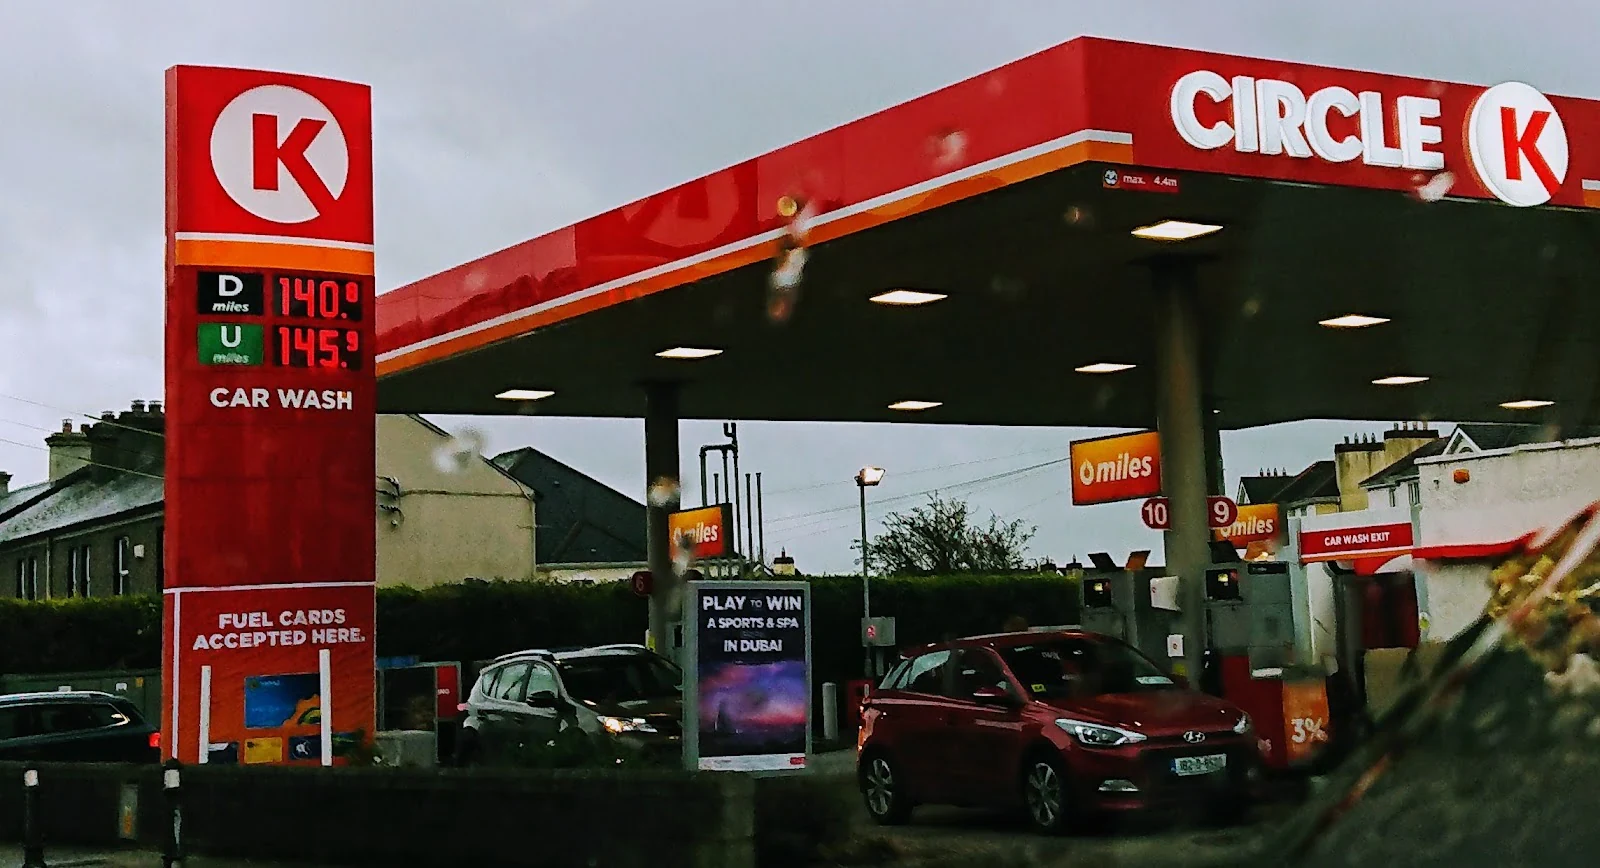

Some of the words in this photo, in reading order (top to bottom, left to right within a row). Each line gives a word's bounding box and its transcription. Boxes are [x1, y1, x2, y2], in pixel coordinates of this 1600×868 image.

[1170, 69, 1445, 170] CIRCLE
[1123, 175, 1146, 185] max.
[1154, 176, 1178, 187] 4.4m
[218, 274, 244, 297] D
[212, 301, 250, 313] miles
[220, 325, 242, 348] U
[210, 387, 270, 408] CAR
[277, 388, 353, 410] WASH
[1144, 502, 1168, 526] 10
[1213, 501, 1230, 524] 9
[1324, 536, 1342, 547] CAR
[1343, 534, 1369, 545] WASH
[1370, 532, 1391, 542] EXIT
[702, 595, 747, 611] PLAY
[750, 599, 763, 608] TO
[765, 595, 802, 611] WIN
[218, 611, 274, 630] FUEL
[279, 608, 346, 627] CARDS
[706, 617, 717, 629] A
[718, 617, 765, 629] SPORTS
[766, 617, 775, 629] &
[776, 617, 800, 629] SPA
[192, 629, 307, 651] ACCEPTED
[311, 627, 366, 644] HERE.
[723, 639, 738, 652] IN
[740, 639, 783, 652] DUBAI
[1290, 716, 1329, 743] 3%
